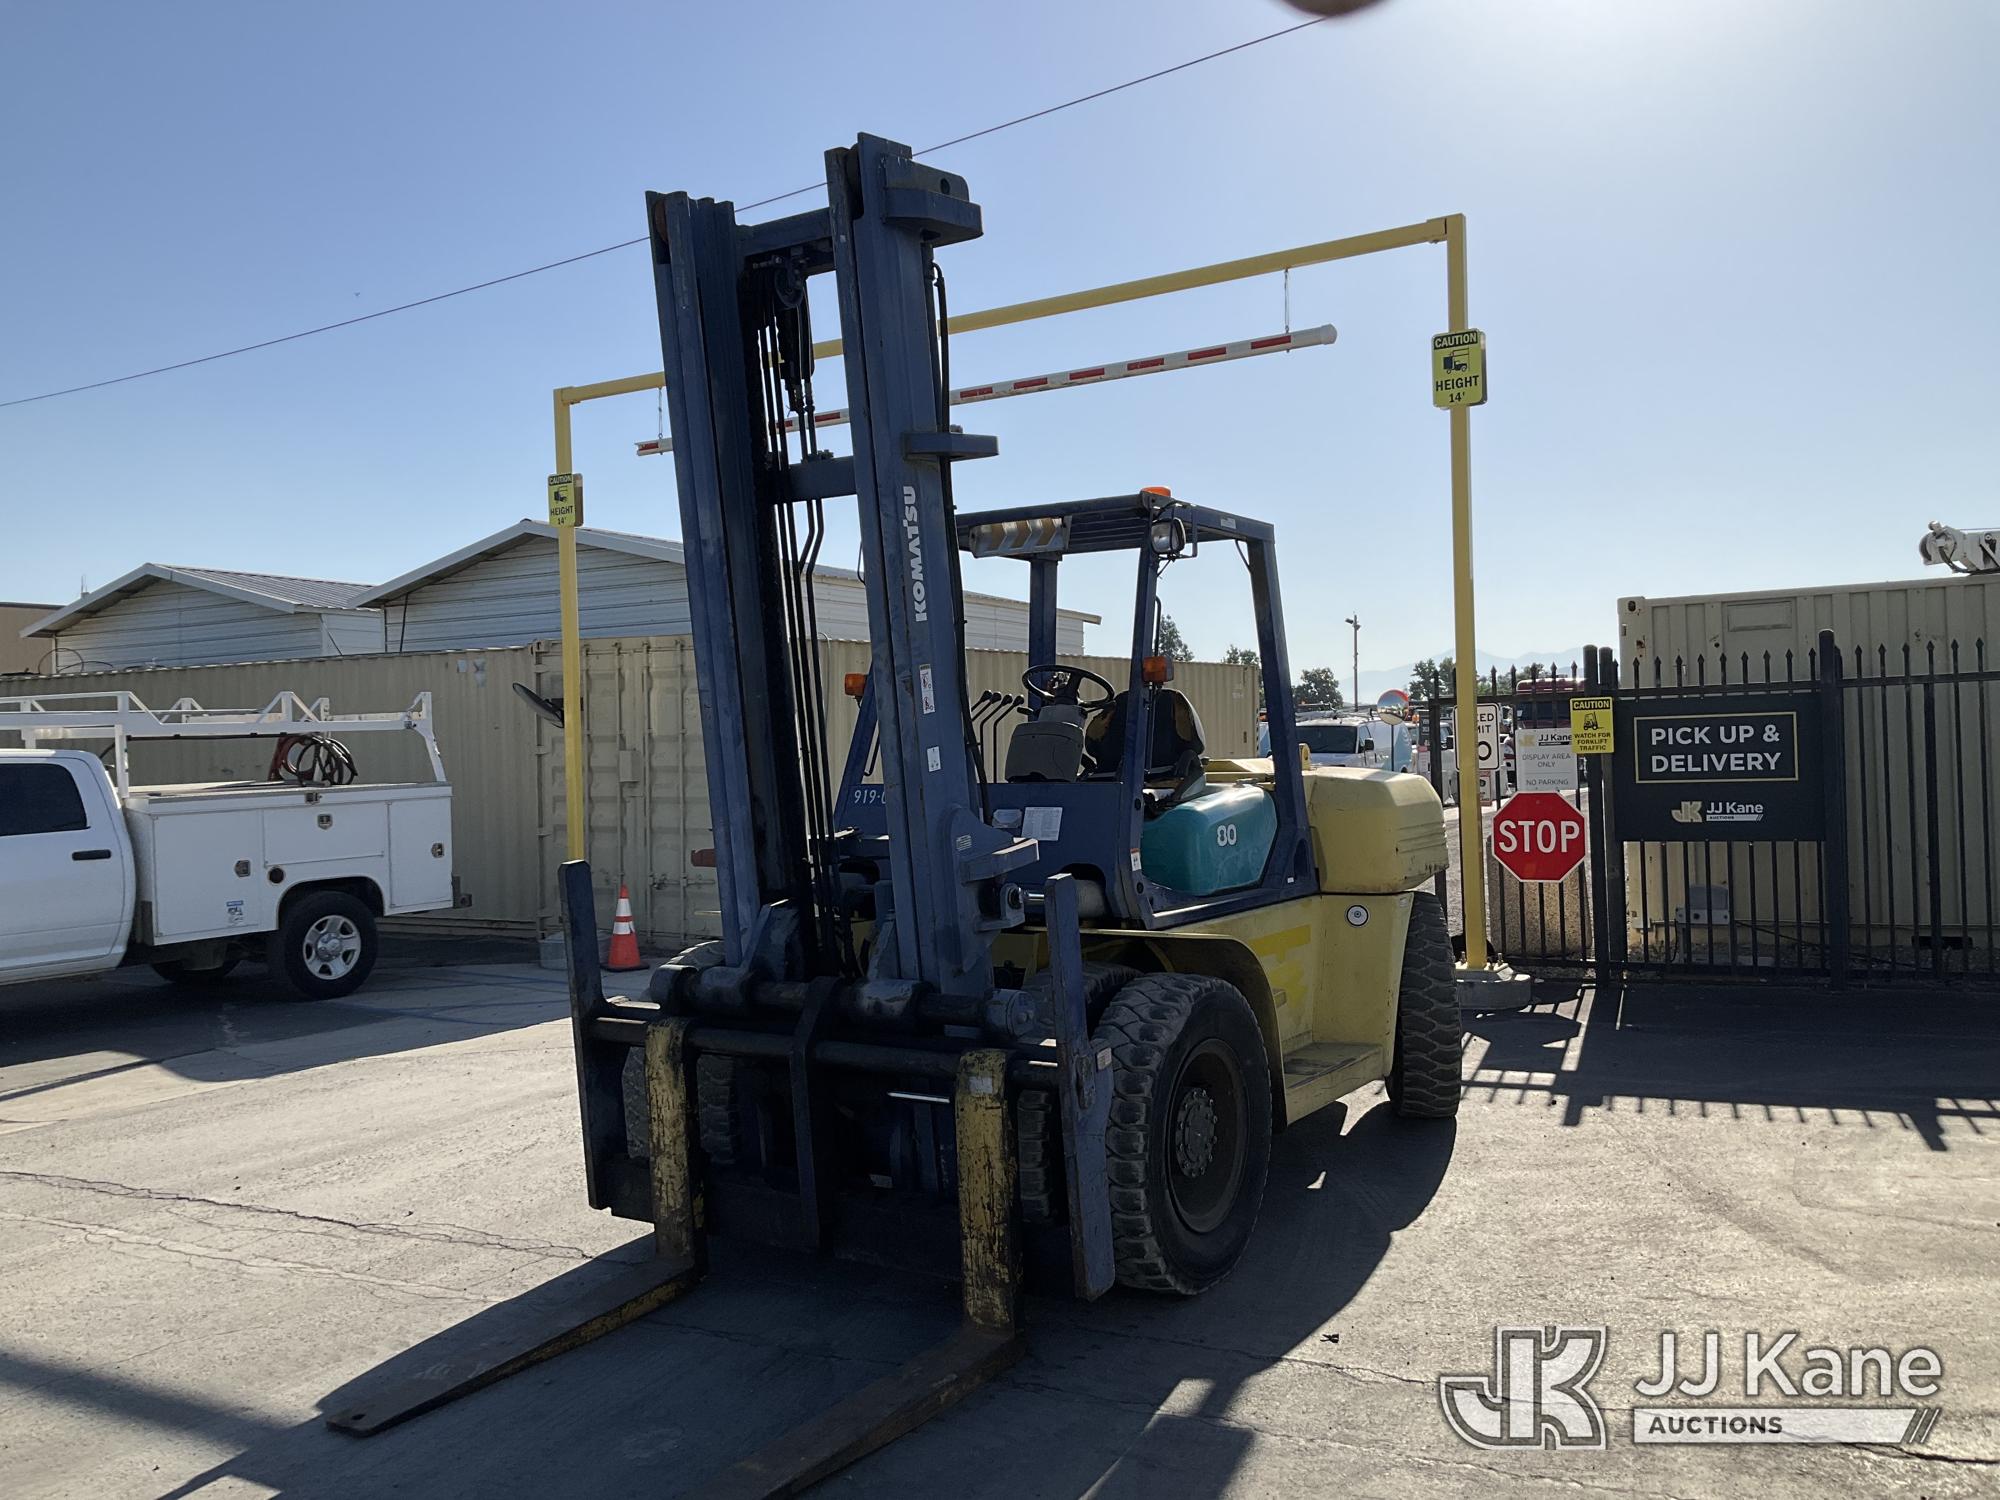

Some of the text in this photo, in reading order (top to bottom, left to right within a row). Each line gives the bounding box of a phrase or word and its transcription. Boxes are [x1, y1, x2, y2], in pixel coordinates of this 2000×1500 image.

[1434, 332, 1477, 348] CAUTION
[1435, 375, 1479, 392] HEIGHT
[1449, 392, 1465, 403] 14'
[550, 506, 573, 516] HEIGHT
[902, 485, 928, 622] KOMATSU
[1573, 700, 1610, 710] CAUTION
[1538, 734, 1549, 742] JJ
[1651, 724, 1780, 746] PICK UP &
[1522, 753, 1550, 761] DISPLAY
[1651, 752, 1782, 773] DELIVERY
[1706, 801, 1764, 814] JJ Kane
[1217, 823, 1237, 847] 80
[1499, 820, 1580, 853] STOP
